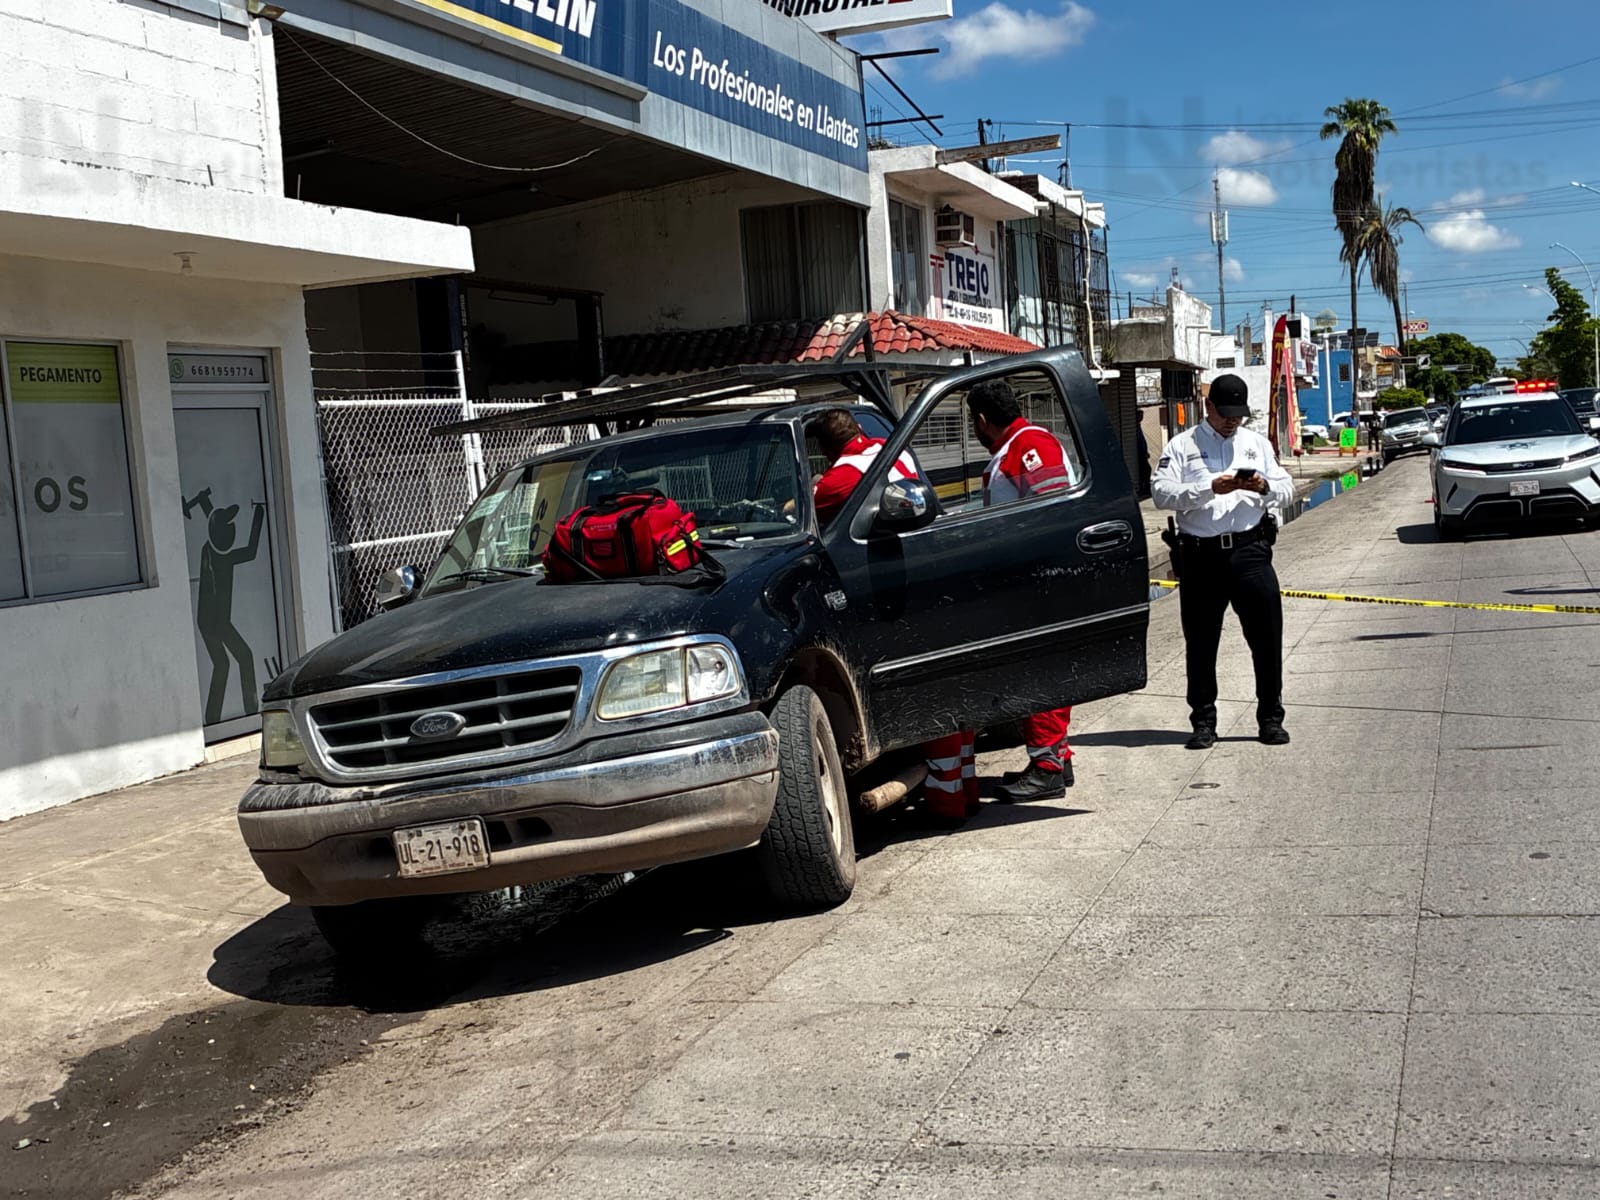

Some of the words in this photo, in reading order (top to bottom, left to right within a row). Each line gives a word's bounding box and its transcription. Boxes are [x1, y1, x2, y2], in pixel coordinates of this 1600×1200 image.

[653, 31, 686, 76] Los
[690, 47, 795, 122] Profesionales
[797, 103, 814, 131] en
[816, 104, 859, 149] Llantas
[945, 252, 989, 298] TREJO
[20, 366, 103, 384] PEGAMENTO
[191, 365, 254, 376] 6681959774
[34, 475, 89, 513] OS
[422, 718, 449, 733] Ford
[399, 834, 480, 865] UL-21-918
